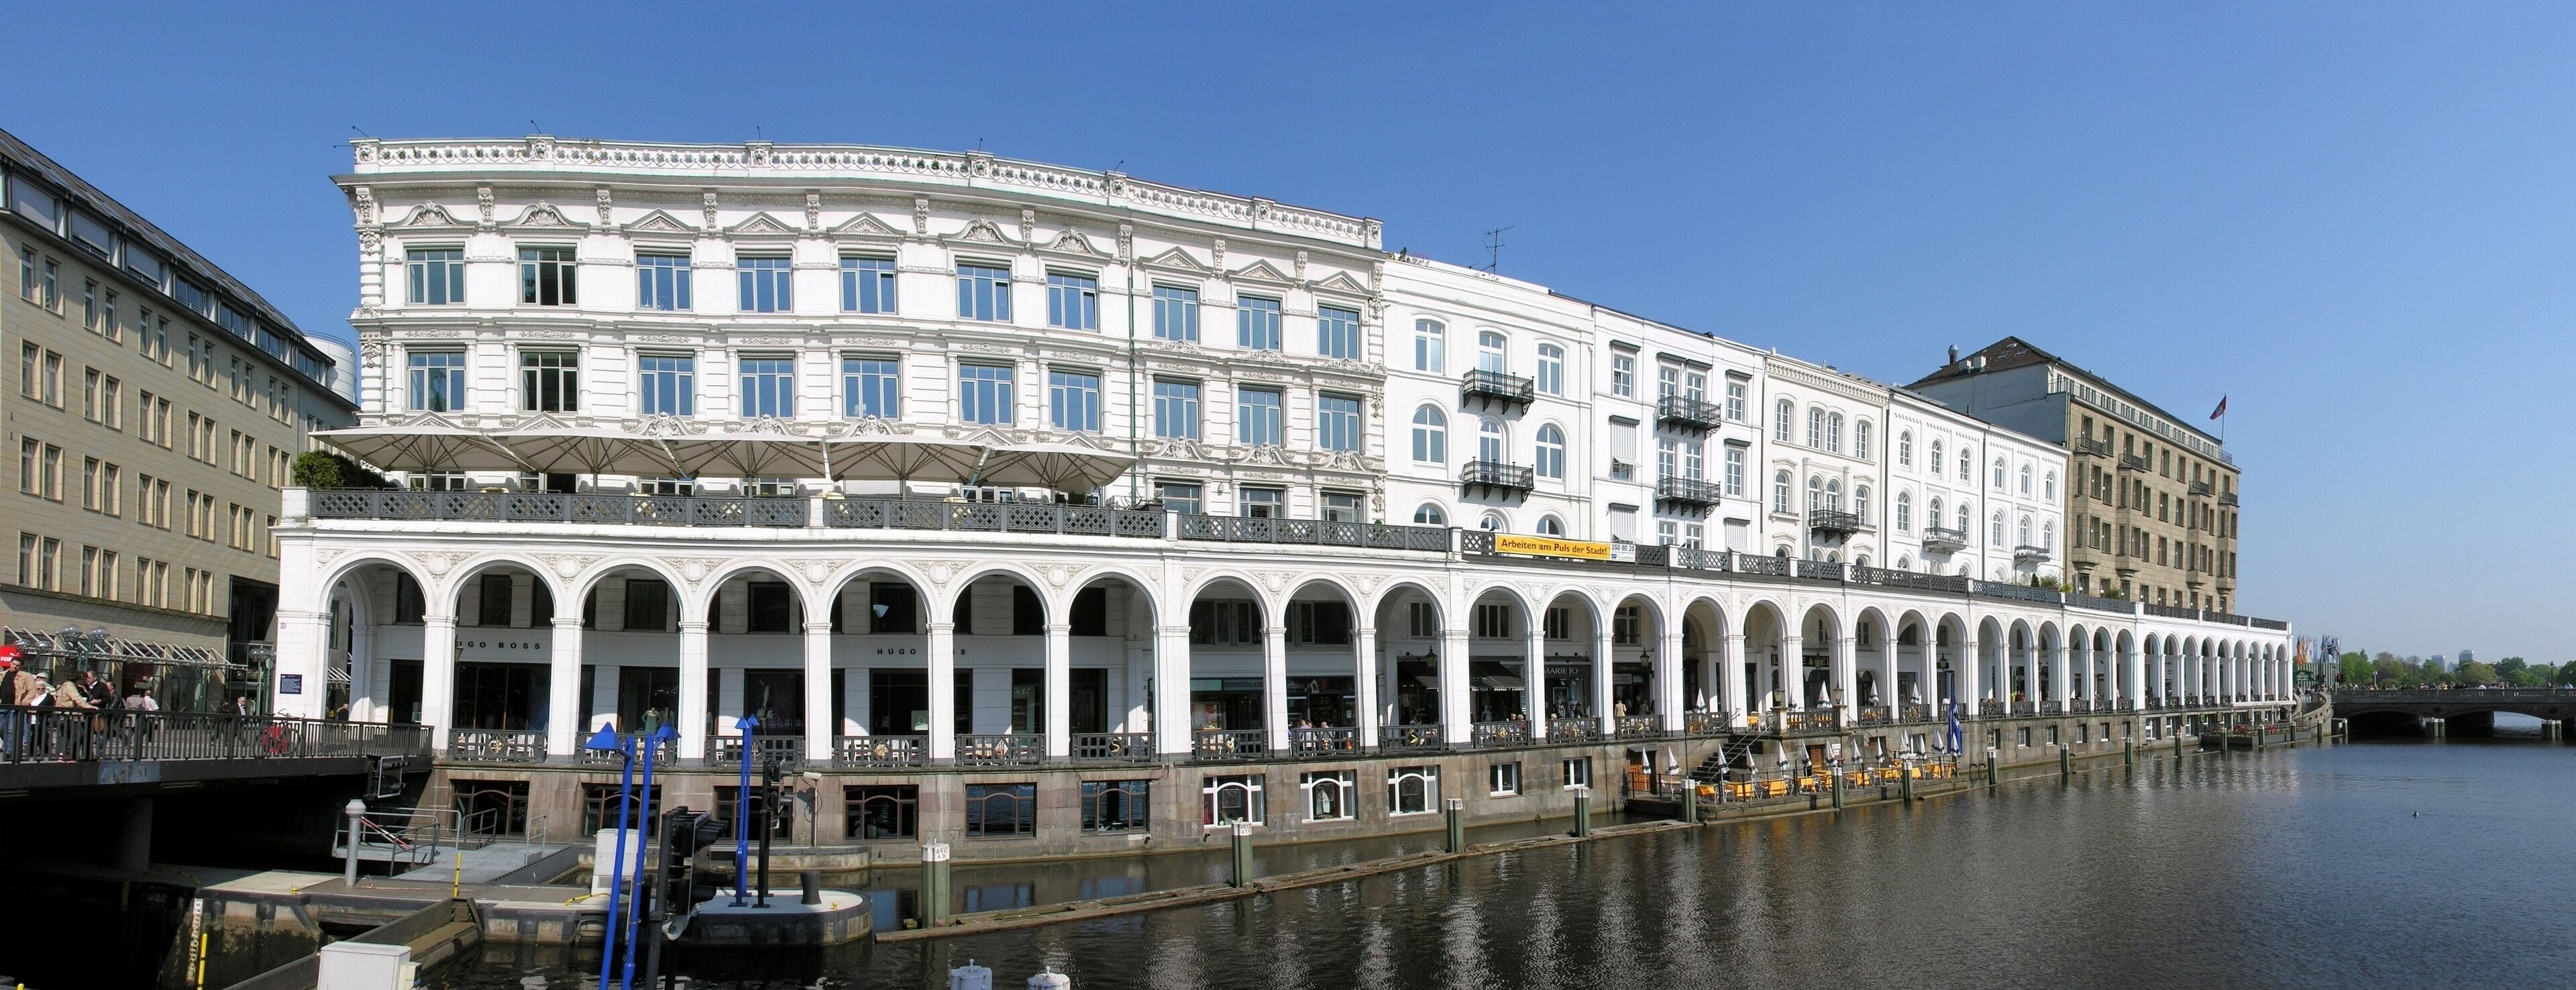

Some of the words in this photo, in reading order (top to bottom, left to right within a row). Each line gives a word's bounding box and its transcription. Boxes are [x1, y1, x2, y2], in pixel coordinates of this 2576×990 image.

[1501, 539, 1536, 549] Arbeiten
[1554, 543, 1570, 552] Puls
[1572, 545, 1585, 553] der
[1586, 546, 1607, 555] Stadt!
[1569, 667, 1578, 675] JO
